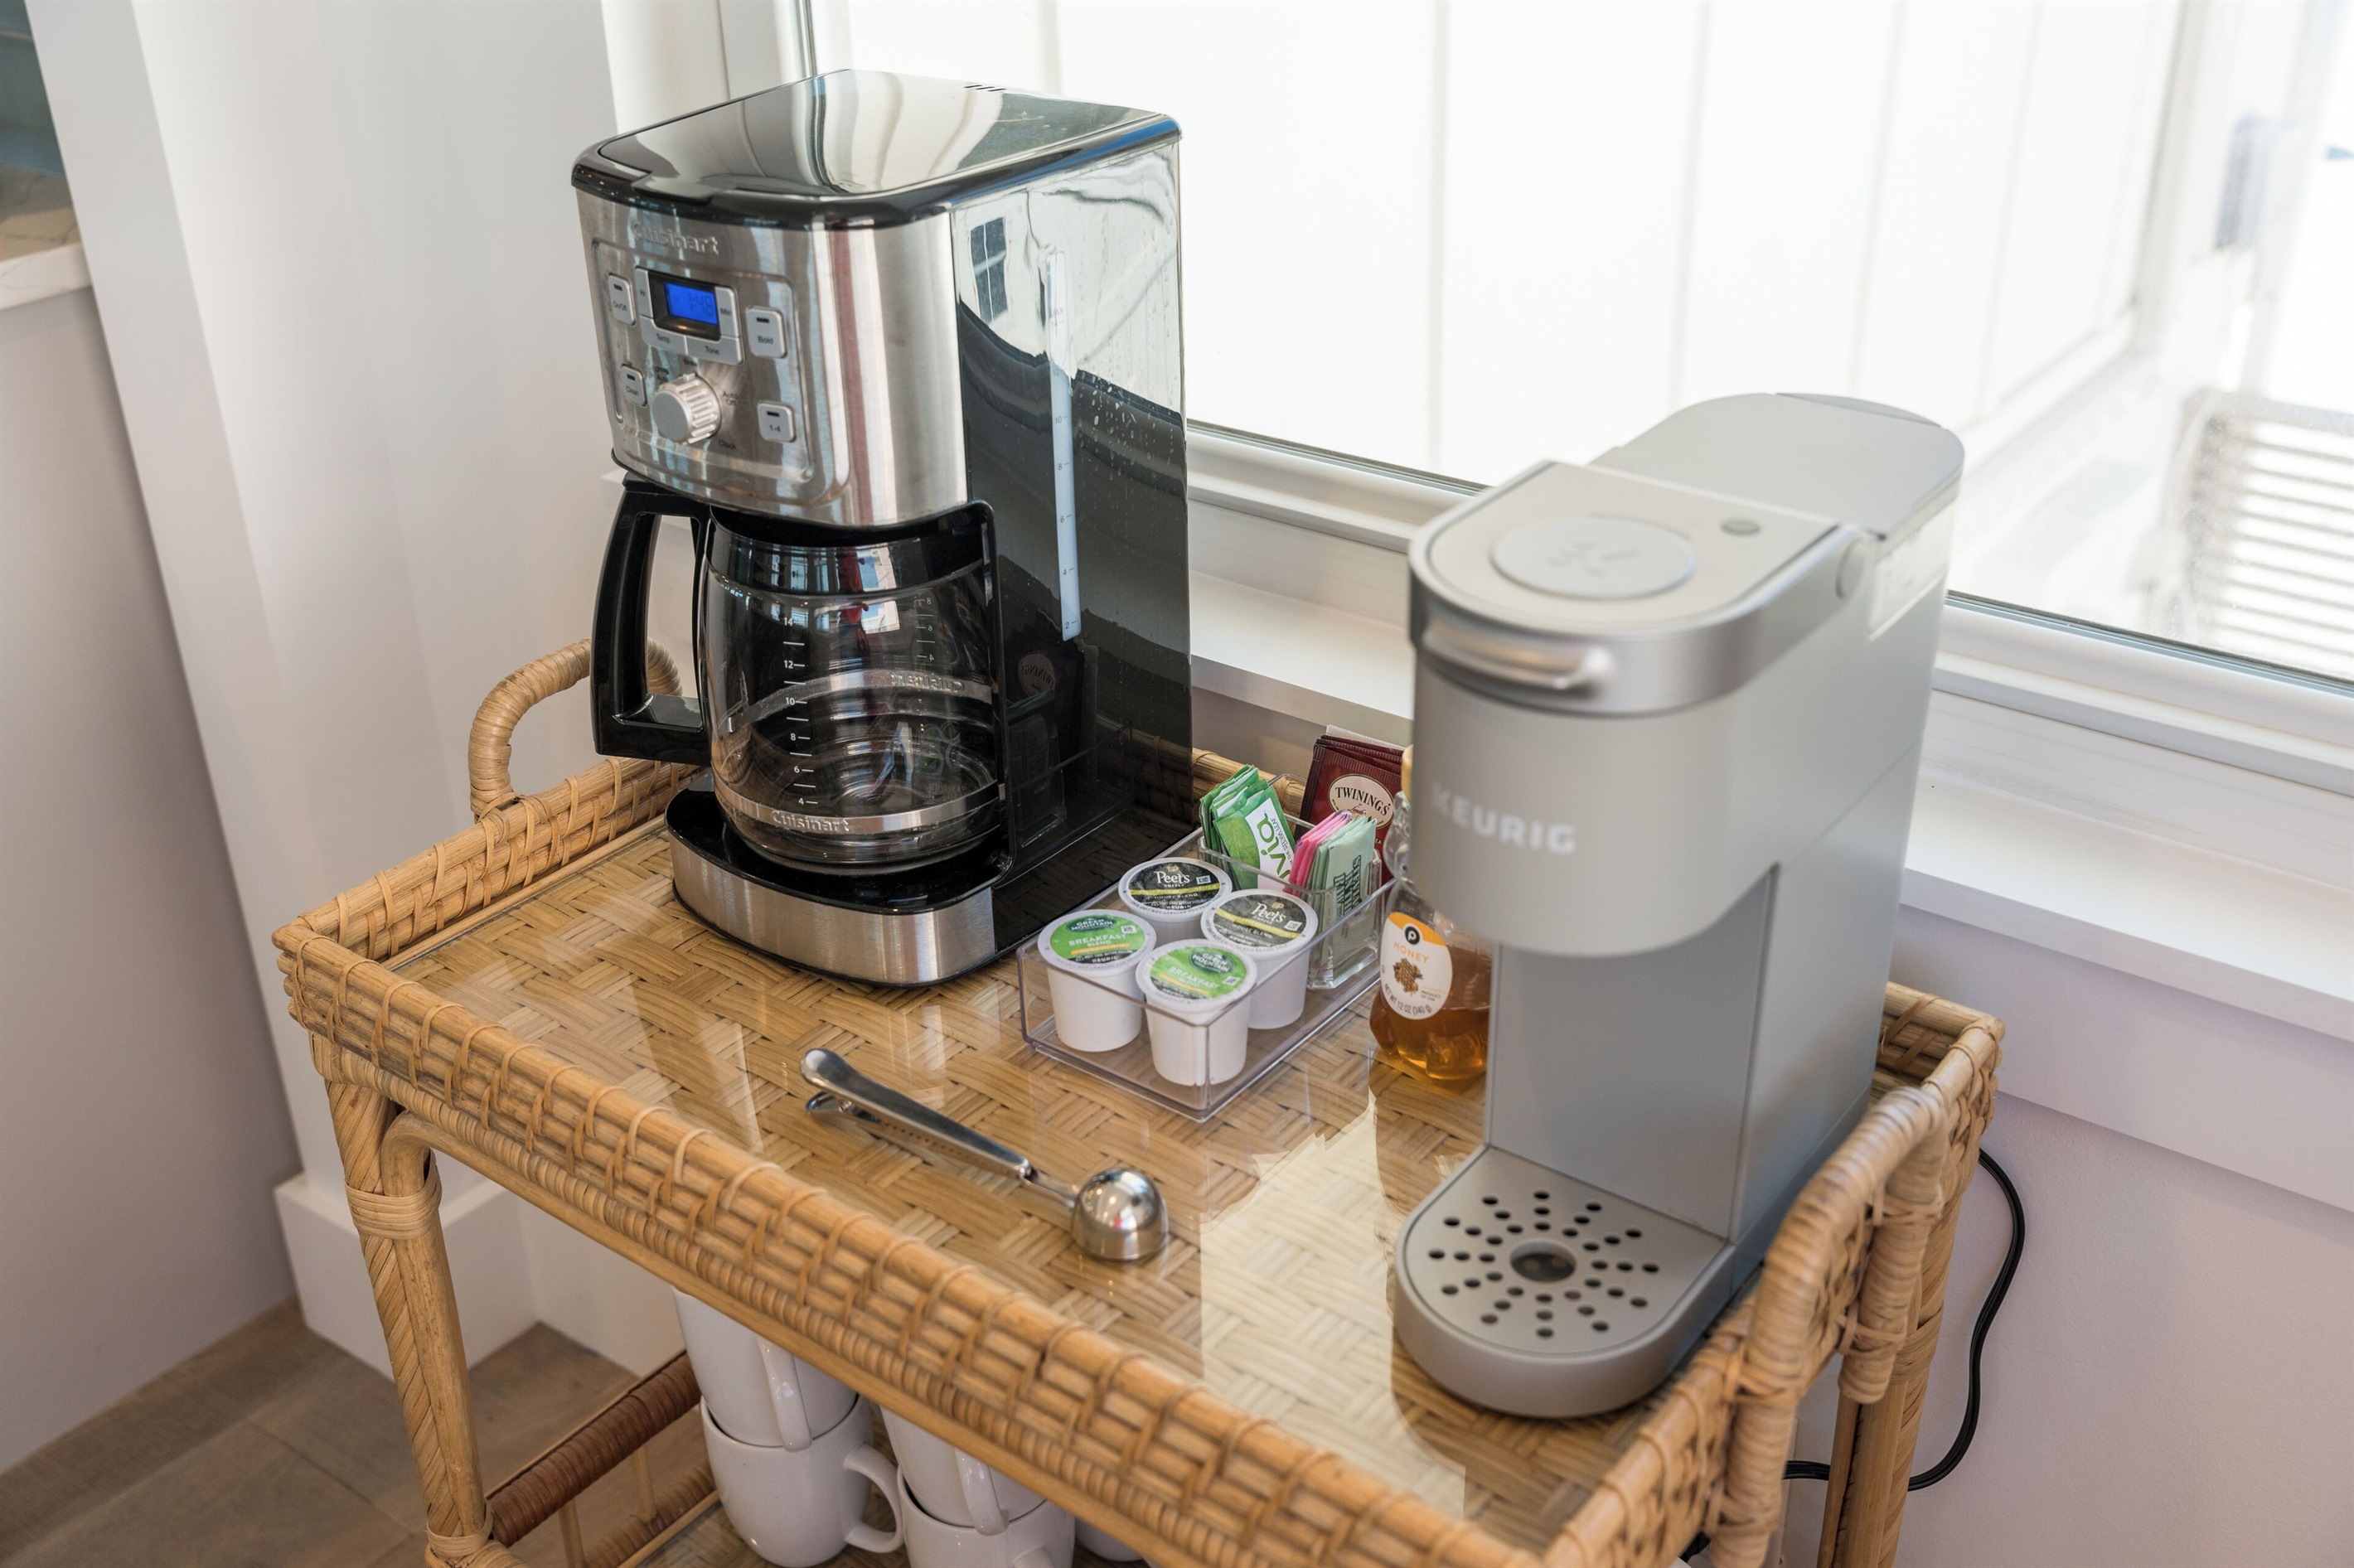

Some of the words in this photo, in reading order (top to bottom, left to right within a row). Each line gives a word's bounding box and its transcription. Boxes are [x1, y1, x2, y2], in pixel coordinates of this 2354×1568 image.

[632, 220, 719, 255] Cuisinart
[688, 292, 714, 317] 1:48
[720, 307, 733, 317] Min
[656, 333, 671, 344] Temp
[758, 335, 774, 345] Bold
[705, 346, 719, 356] Tone
[626, 385, 639, 397] Clean
[723, 390, 739, 399] Auto
[1054, 415, 1063, 424] 10
[769, 424, 781, 433] 1-4
[719, 439, 736, 450] Clock
[1058, 462, 1063, 471] 8
[1060, 515, 1065, 524] 6
[1063, 569, 1068, 577] 4
[783, 617, 793, 627] 14
[1065, 622, 1070, 630] 2
[784, 660, 794, 669] 12
[785, 697, 796, 705] 10
[790, 733, 797, 741] 8
[797, 797, 805, 806] 4
[1335, 786, 1390, 816] TWININGS
[771, 811, 850, 832] Cuisinart
[1431, 782, 1576, 854] KEURIG
[1068, 933, 1126, 946] BREAKFAST
[1393, 941, 1429, 963] HONEY
